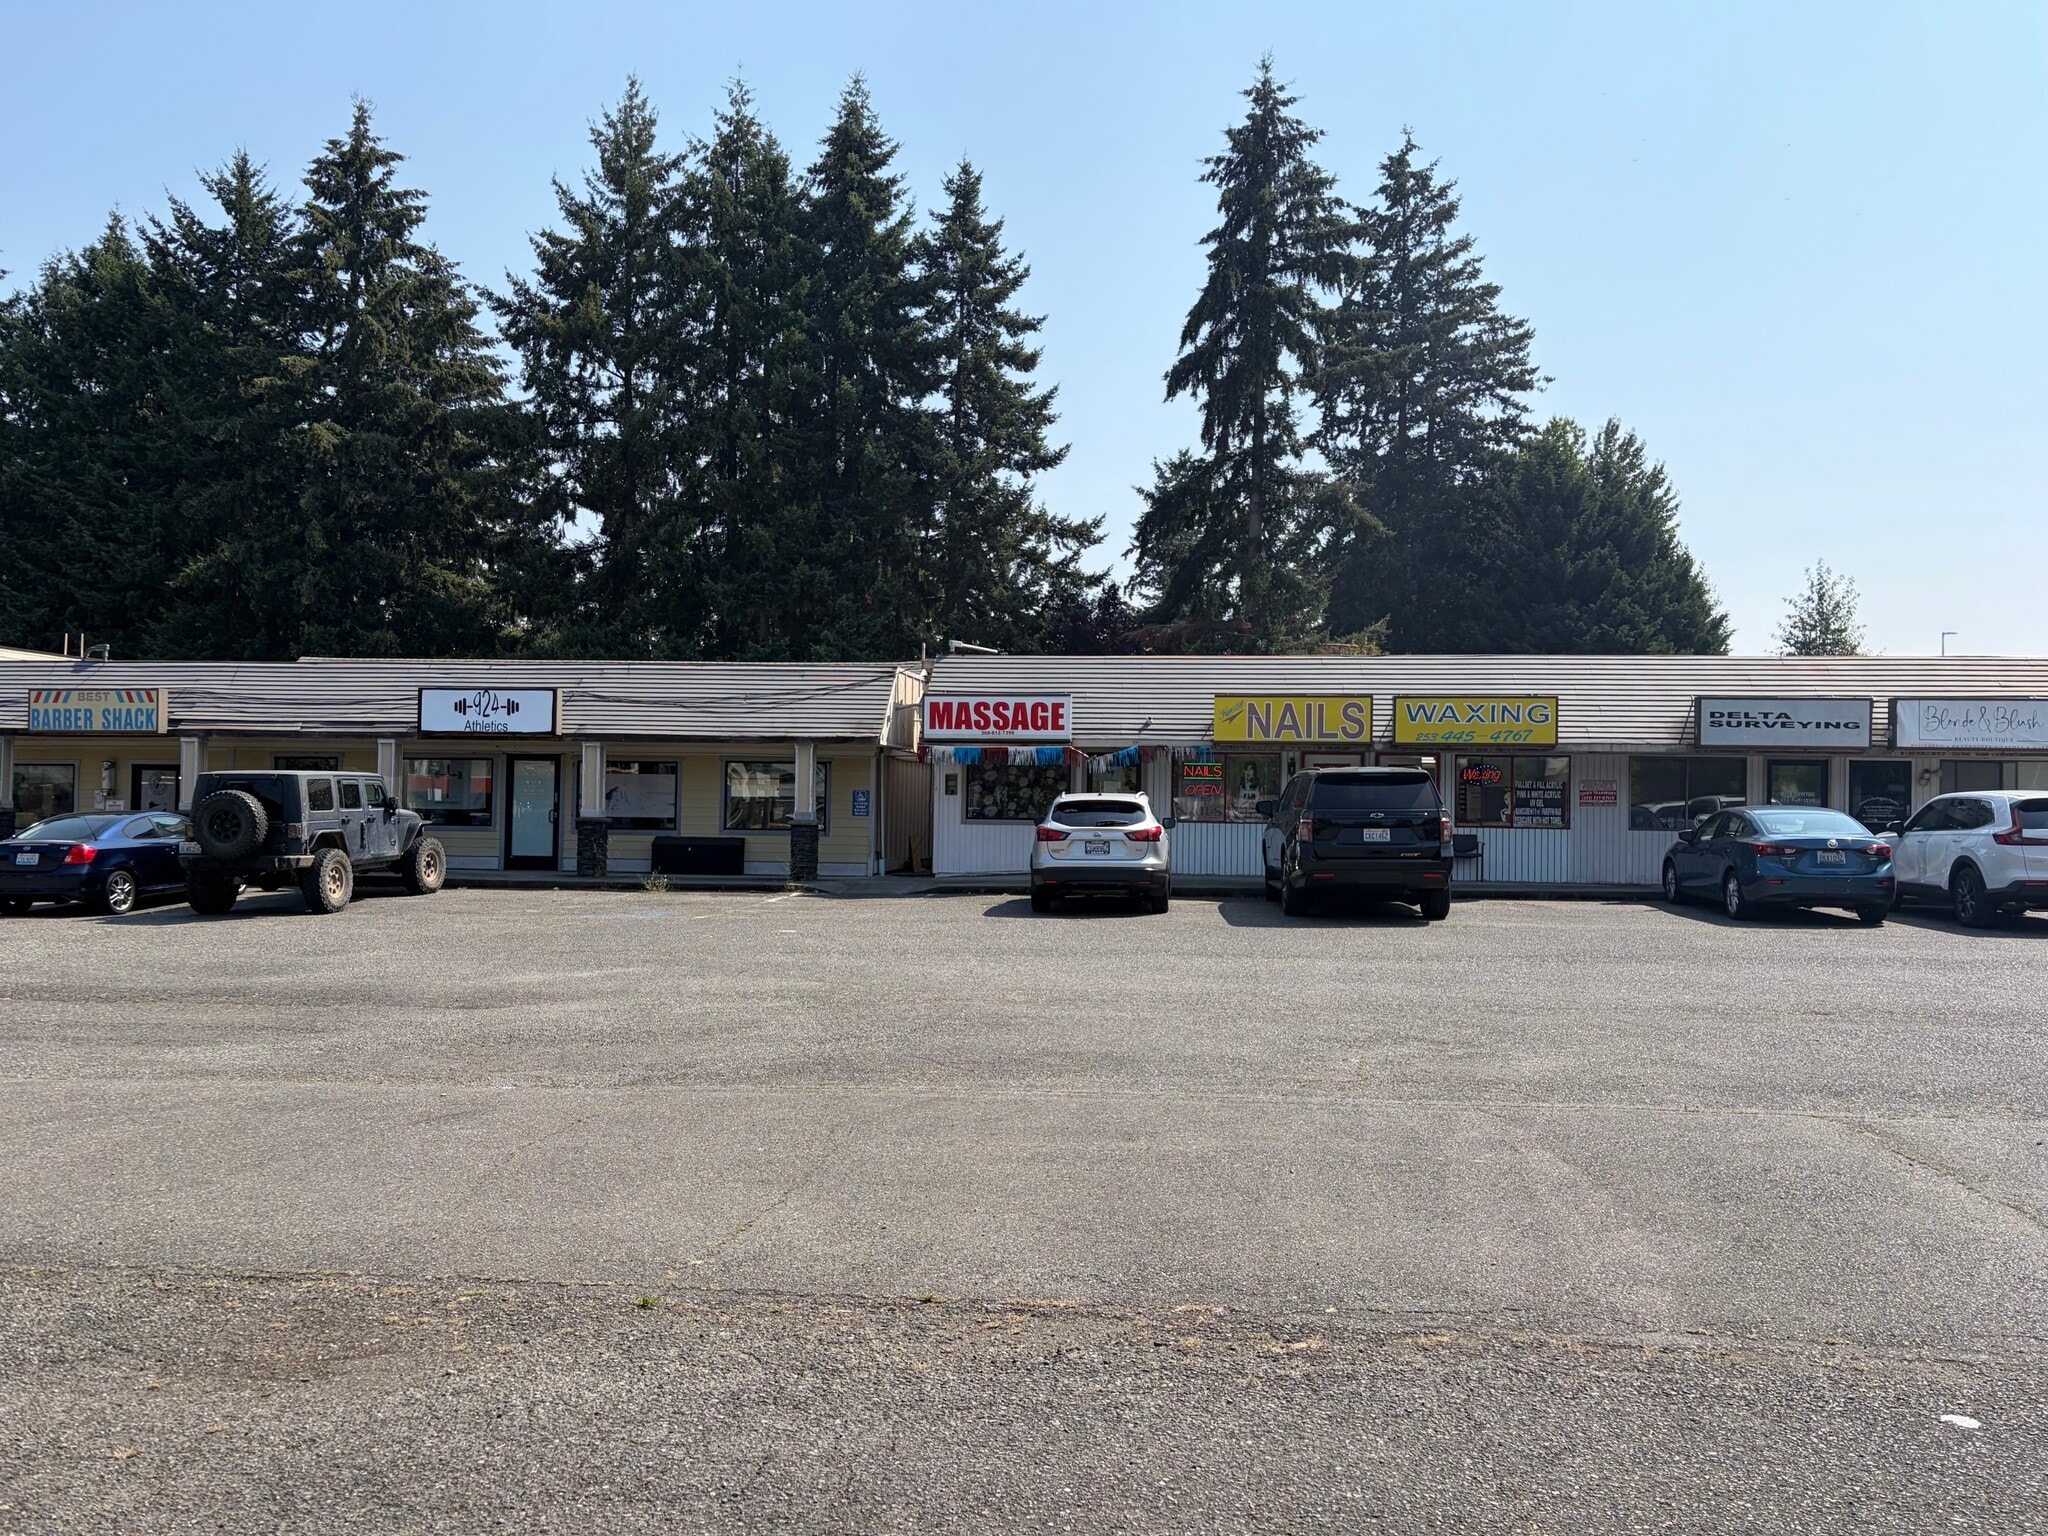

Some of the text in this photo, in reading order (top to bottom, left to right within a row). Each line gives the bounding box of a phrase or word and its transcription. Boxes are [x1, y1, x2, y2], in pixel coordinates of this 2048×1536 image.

[77, 691, 110, 702] BEST
[473, 690, 499, 717] 924
[31, 708, 155, 730] BARBER SHACK
[929, 701, 1065, 731] MASSAGE
[1404, 702, 1551, 724] WAXING
[1709, 711, 1792, 720] DELTA
[1247, 702, 1366, 740] NAILS
[1709, 720, 1861, 730] SURVEYING
[1924, 706, 2045, 733] Blonde & Blush
[464, 720, 508, 732] Athletics
[1415, 732, 1439, 742] 253
[1981, 736, 2014, 744] BOUTIQUE
[1183, 765, 1222, 778] NAILS
[1463, 768, 1502, 783] Waxing
[1185, 784, 1222, 796] OPEN
[1537, 780, 1545, 789] FILL
[1546, 780, 1562, 789] ACRYLIC
[1516, 790, 1526, 798] PINK
[1544, 790, 1561, 798] ACRYLIC
[1536, 799, 1544, 807] GEL
